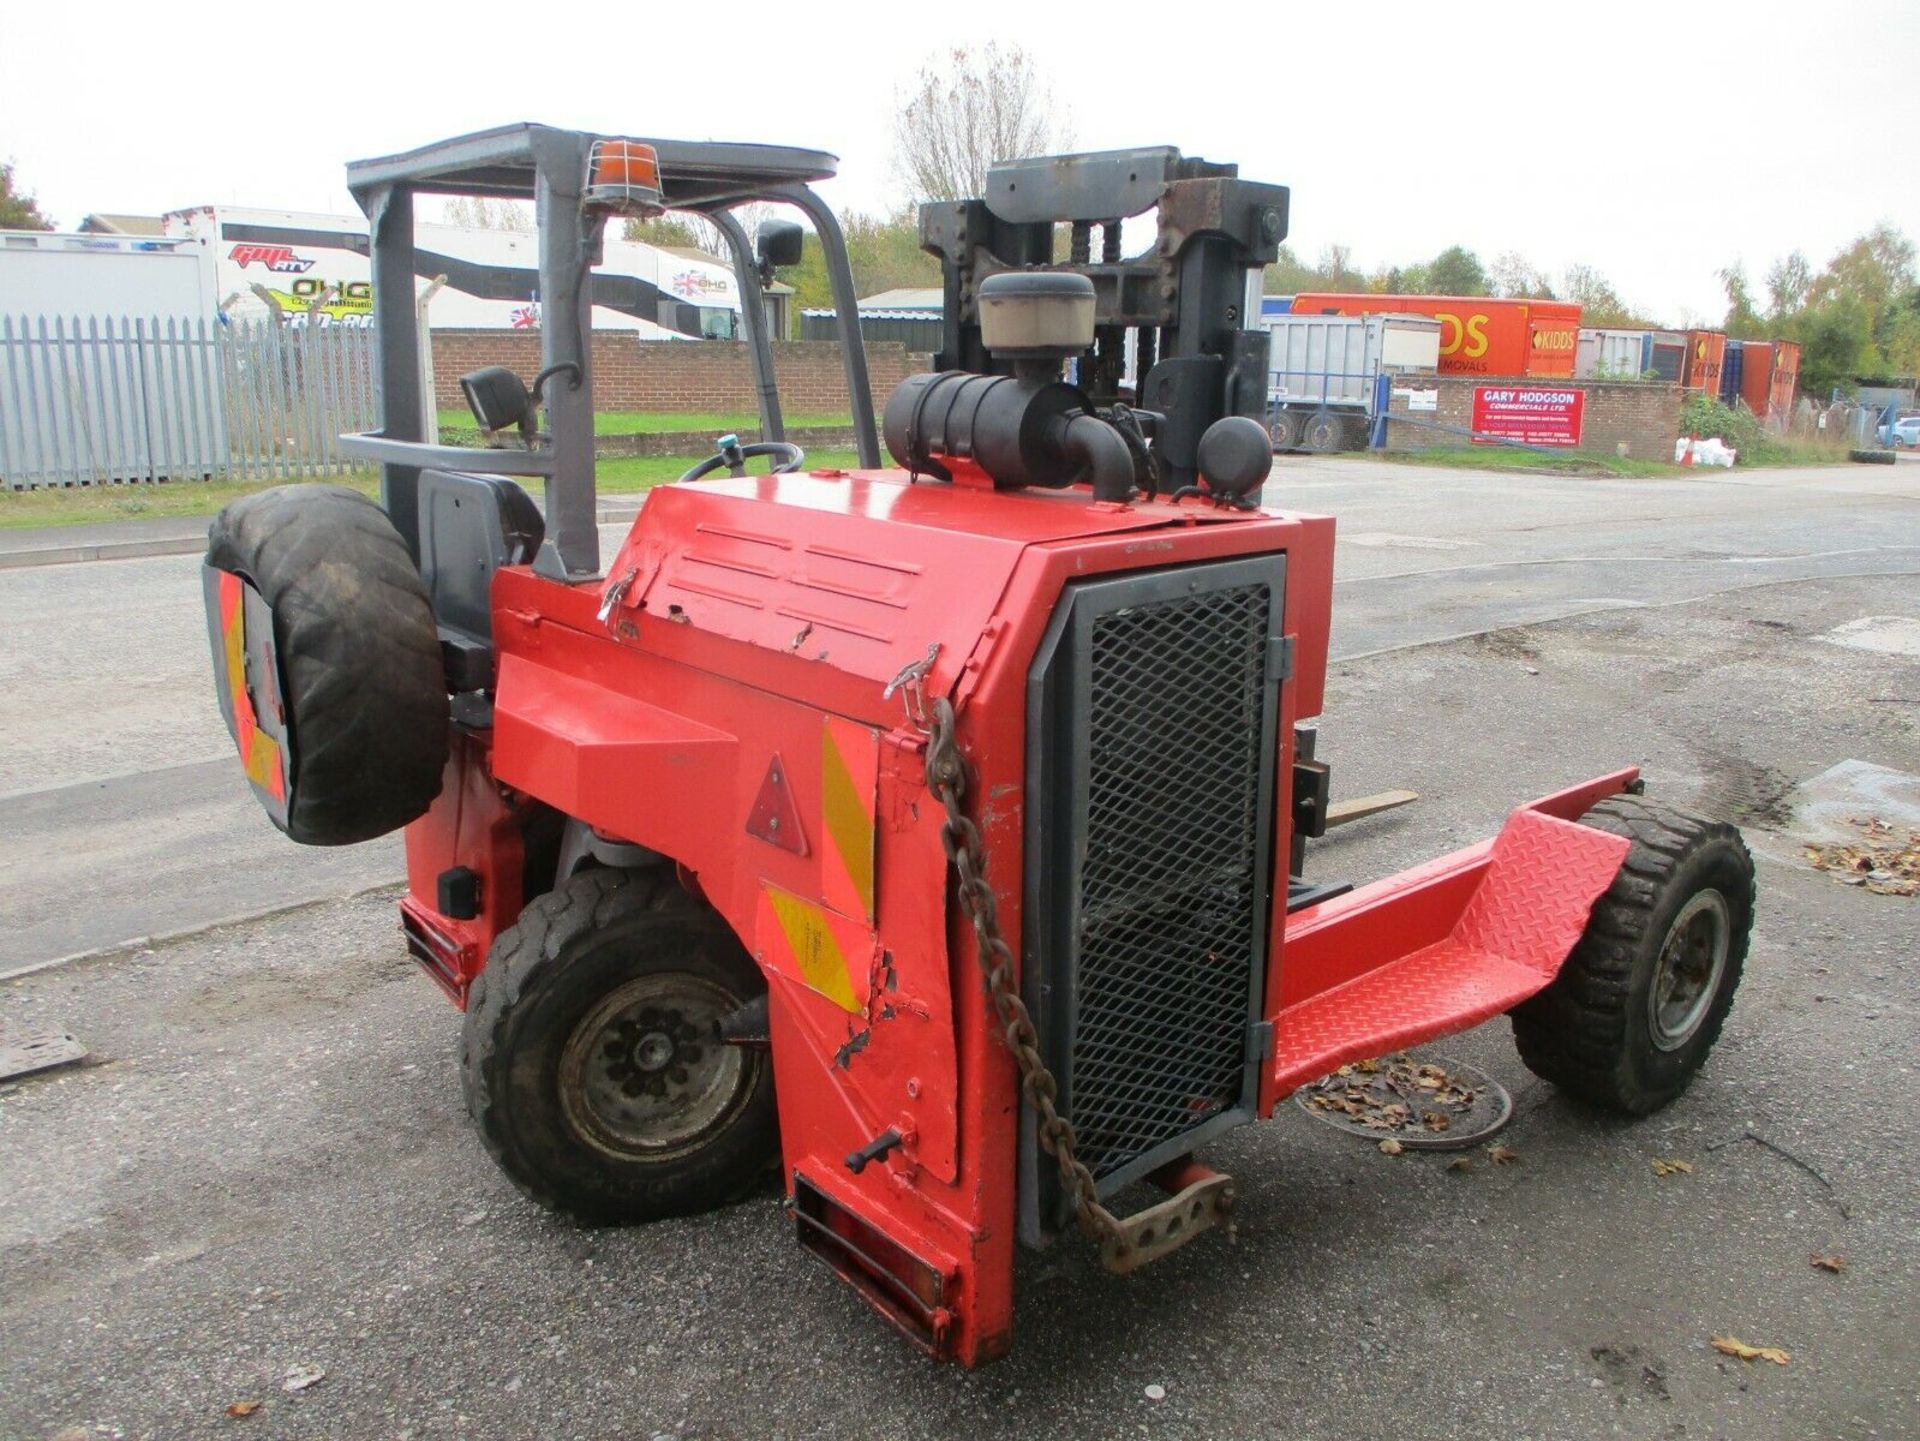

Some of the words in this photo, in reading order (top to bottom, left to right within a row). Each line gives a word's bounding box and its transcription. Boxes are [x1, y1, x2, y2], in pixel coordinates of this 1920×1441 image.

[274, 260, 313, 271] ATV
[1541, 331, 1574, 350] KIDDS
[1483, 390, 1516, 402] GARY
[1519, 392, 1575, 404] HODGSON
[1489, 402, 1547, 412] COMMERCIALS
